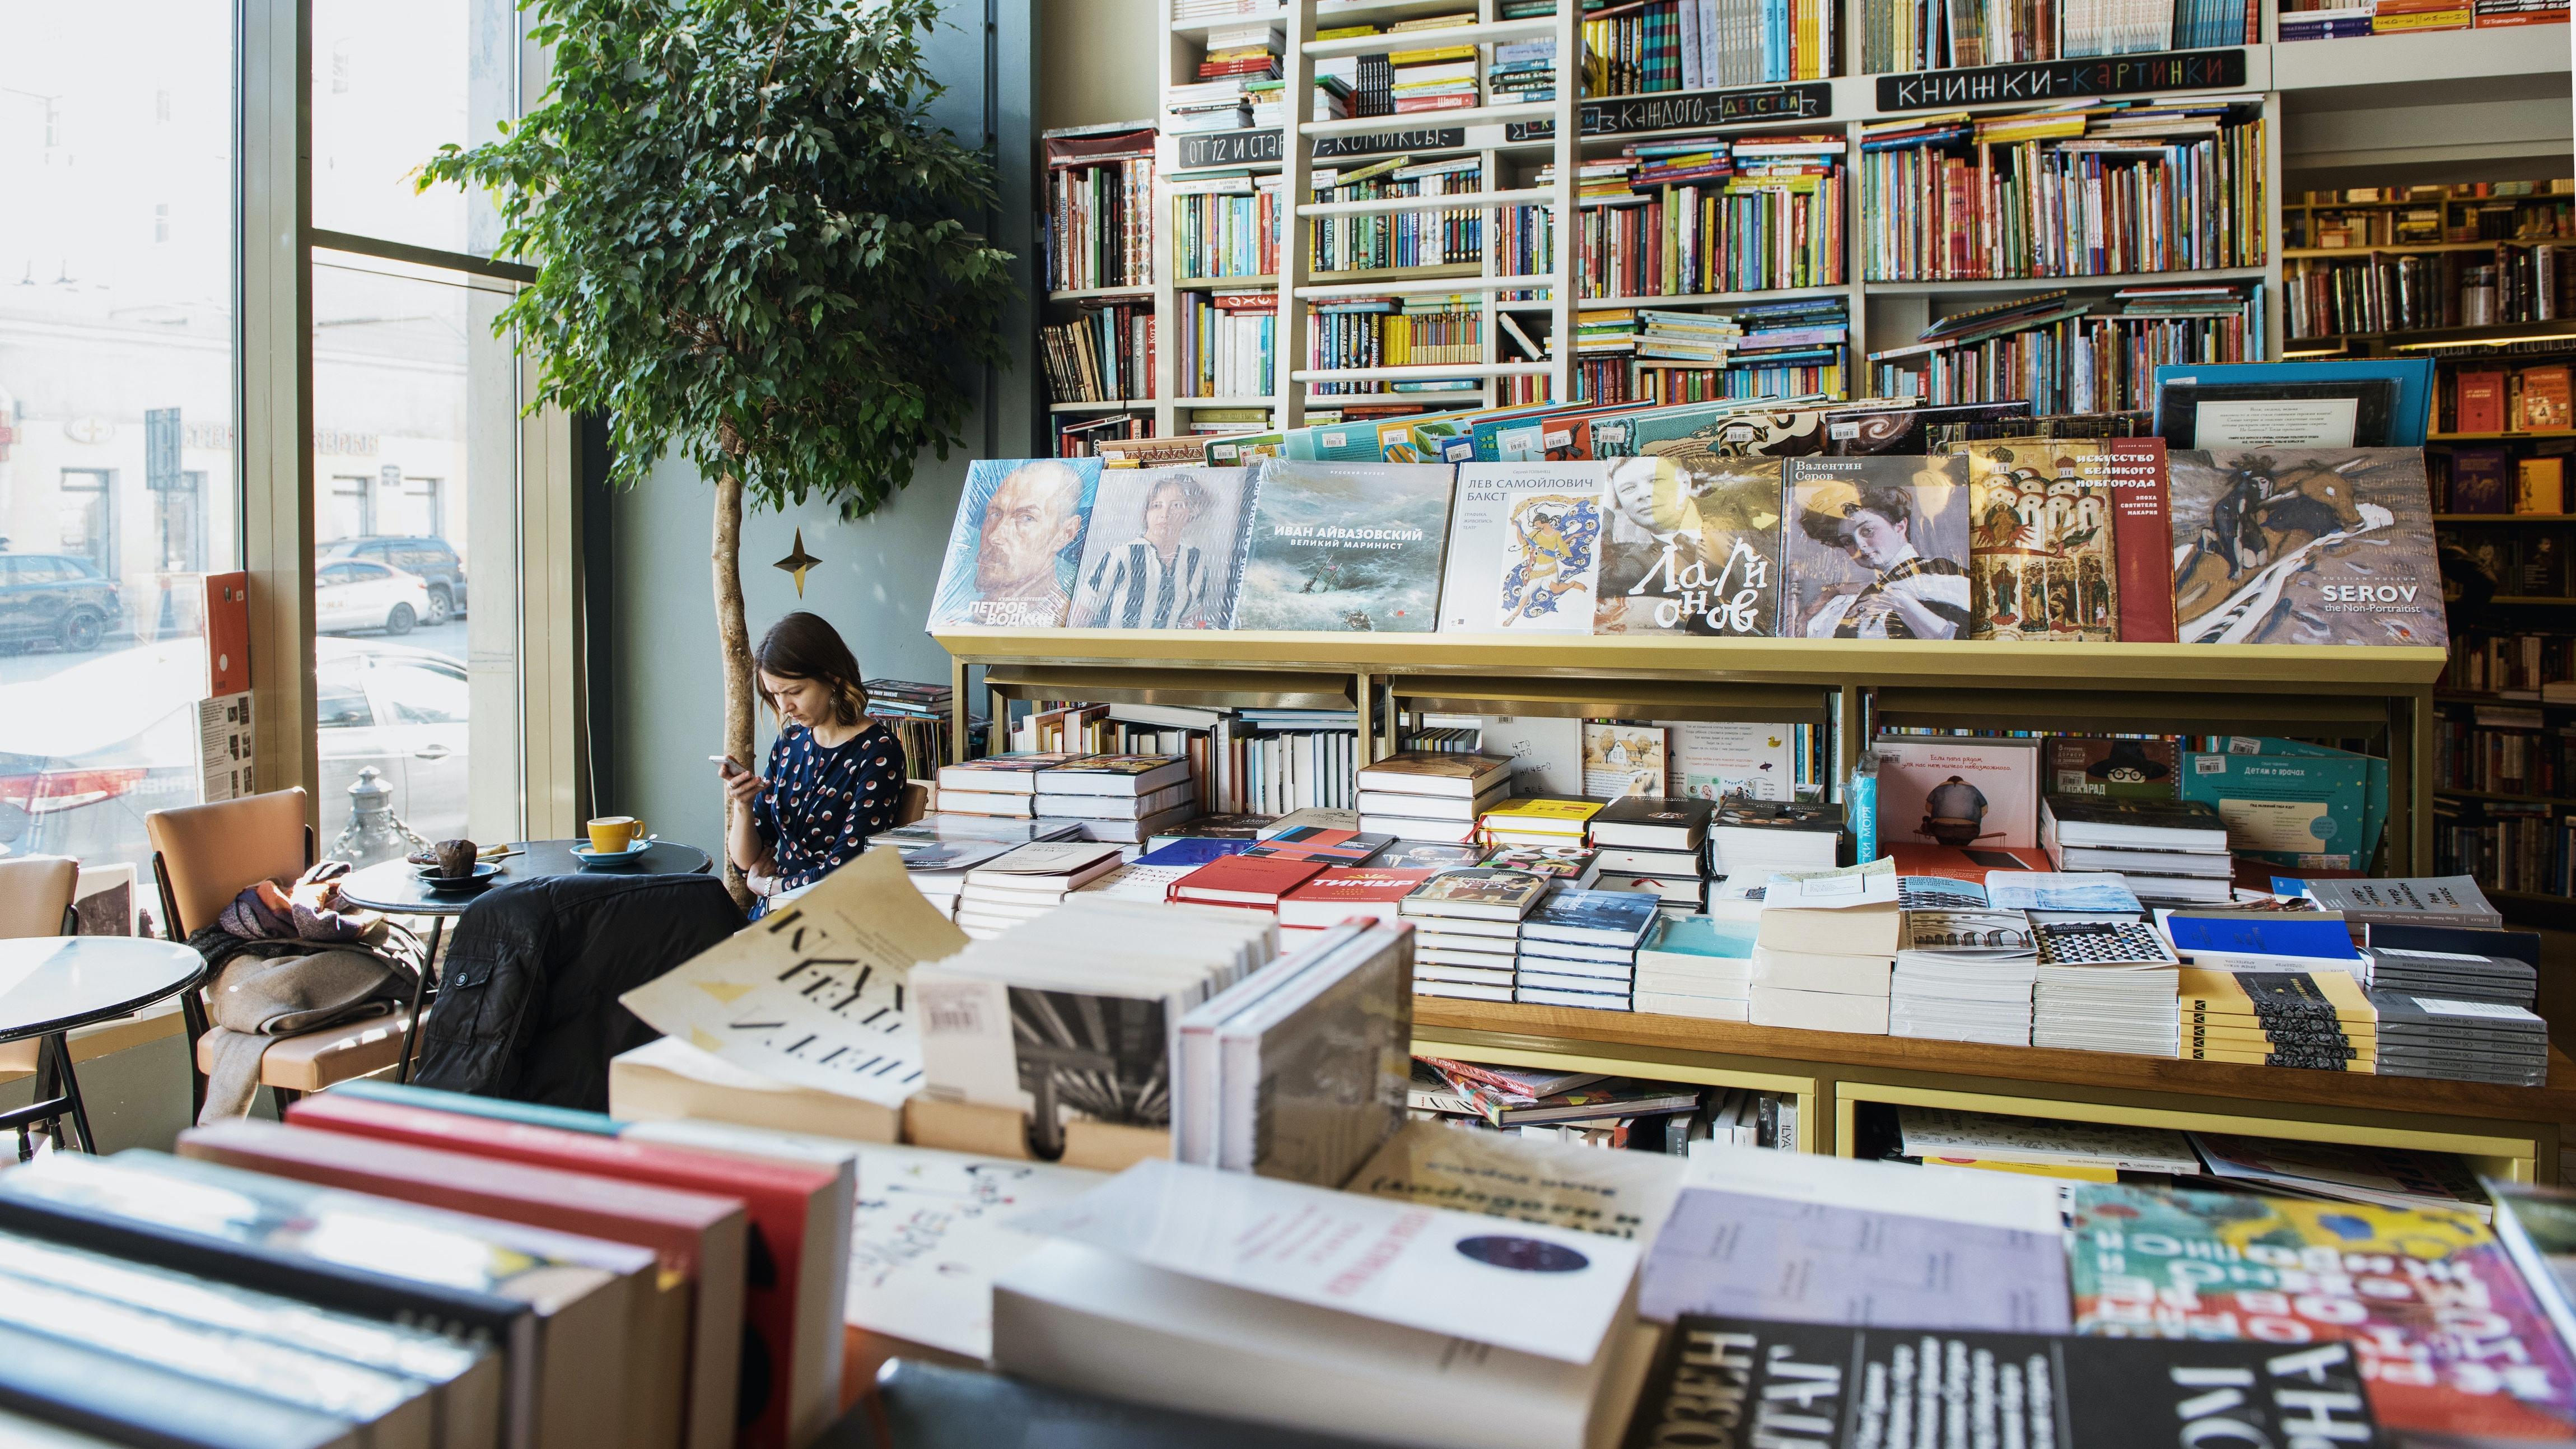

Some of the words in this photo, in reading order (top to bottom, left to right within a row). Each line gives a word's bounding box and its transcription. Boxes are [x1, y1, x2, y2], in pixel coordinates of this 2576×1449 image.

[1437, 96, 1462, 107] Шансы
[1724, 93, 1799, 116] ДЕТСТВА
[1189, 139, 1208, 164] ОТ
[1234, 138, 1244, 159] И
[1324, 219, 1333, 249] ЭЛАНУ
[1795, 460, 1862, 471] Валентин
[2084, 466, 2155, 475] ВЕЛИКОГО
[1468, 479, 1493, 488] ЛЕВ
[1496, 477, 1593, 488] САМОЙЛОВИЧ
[1795, 471, 1833, 483] Серов
[2075, 479, 2156, 489] НОВГОРОДА
[1467, 491, 1508, 502] БАКСТ
[1274, 525, 1314, 538] ИВАН
[1317, 525, 1423, 542] АЙВАЗОВСКИЙ
[1290, 538, 1341, 548] ВЕЛИКИЙ
[1344, 541, 1403, 551] МАРИНИСТ
[2322, 585, 2419, 603] SEROV
[968, 601, 1028, 614] ПЕТРОВ
[2325, 604, 2341, 613] the
[2344, 603, 2421, 614] Non-Portraitist
[986, 613, 1056, 627] ВОДКИН
[2244, 767, 2270, 775] Детям
[2057, 784, 2106, 796] МАСКАРАД
[1863, 805, 1872, 840] МОРЯ
[1312, 879, 1416, 887] ТИМУР
[2387, 888, 2408, 906] Питер
[2427, 892, 2443, 904] Рем
[2429, 965, 2476, 973] художественной
[2428, 975, 2475, 983] художественной
[1438, 1058, 1457, 1069] UTOPIA
[1507, 1083, 1529, 1094] CHICAGO
[1781, 1124, 1792, 1148] ILYA
